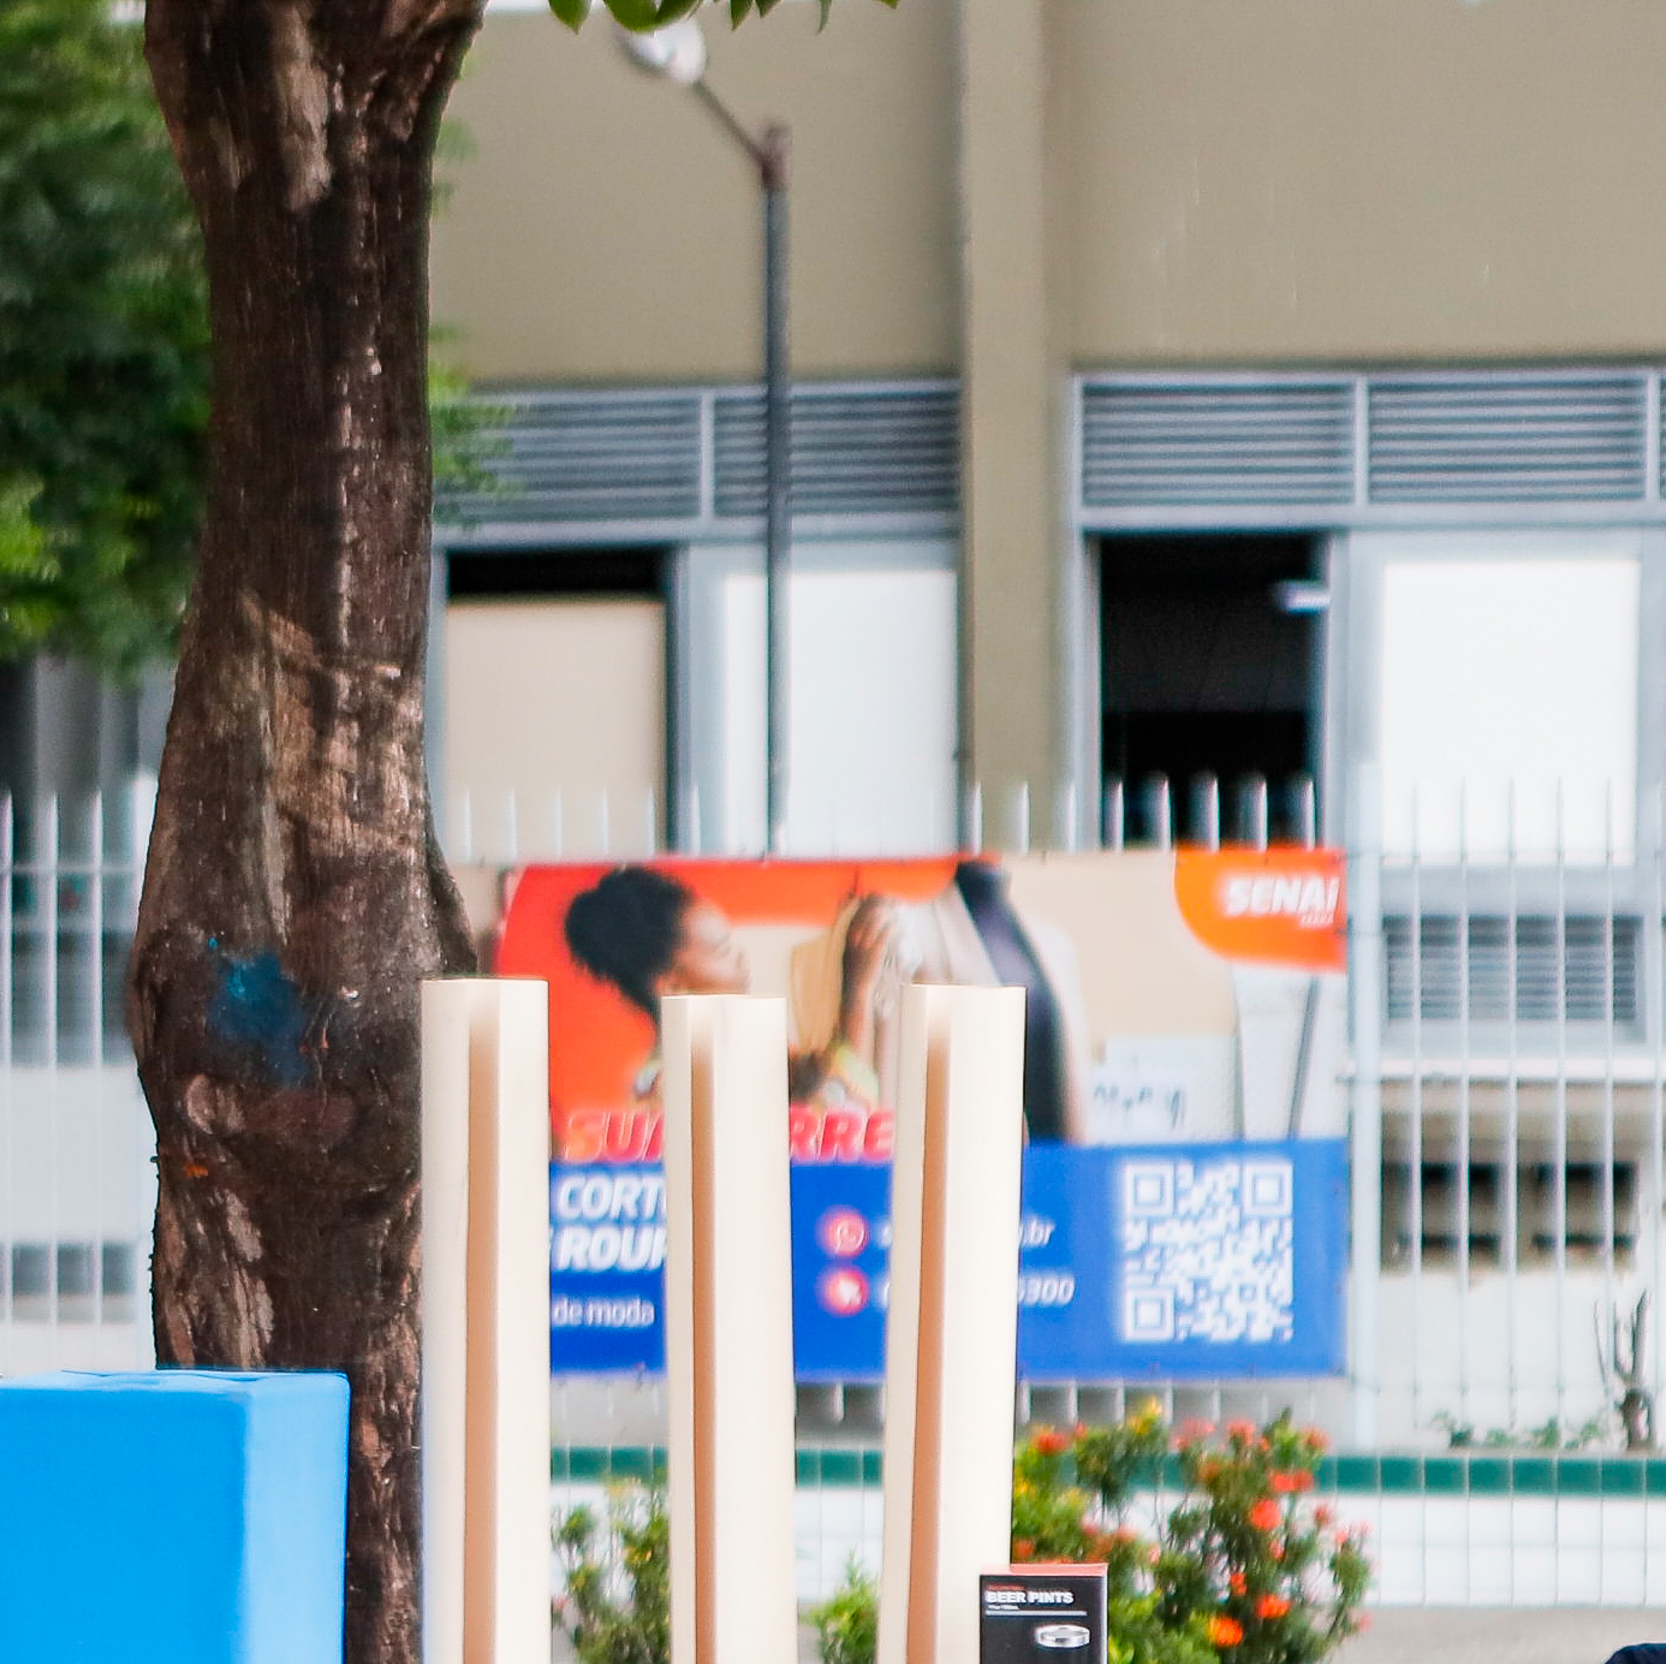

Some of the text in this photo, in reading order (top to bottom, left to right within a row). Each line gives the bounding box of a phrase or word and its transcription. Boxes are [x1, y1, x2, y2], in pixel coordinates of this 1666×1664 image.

[1225, 876, 1341, 915] SENAI
[557, 1175, 667, 1220] CORT
[553, 1299, 656, 1326] de moda
[985, 1591, 1075, 1604] BEER PINTS
